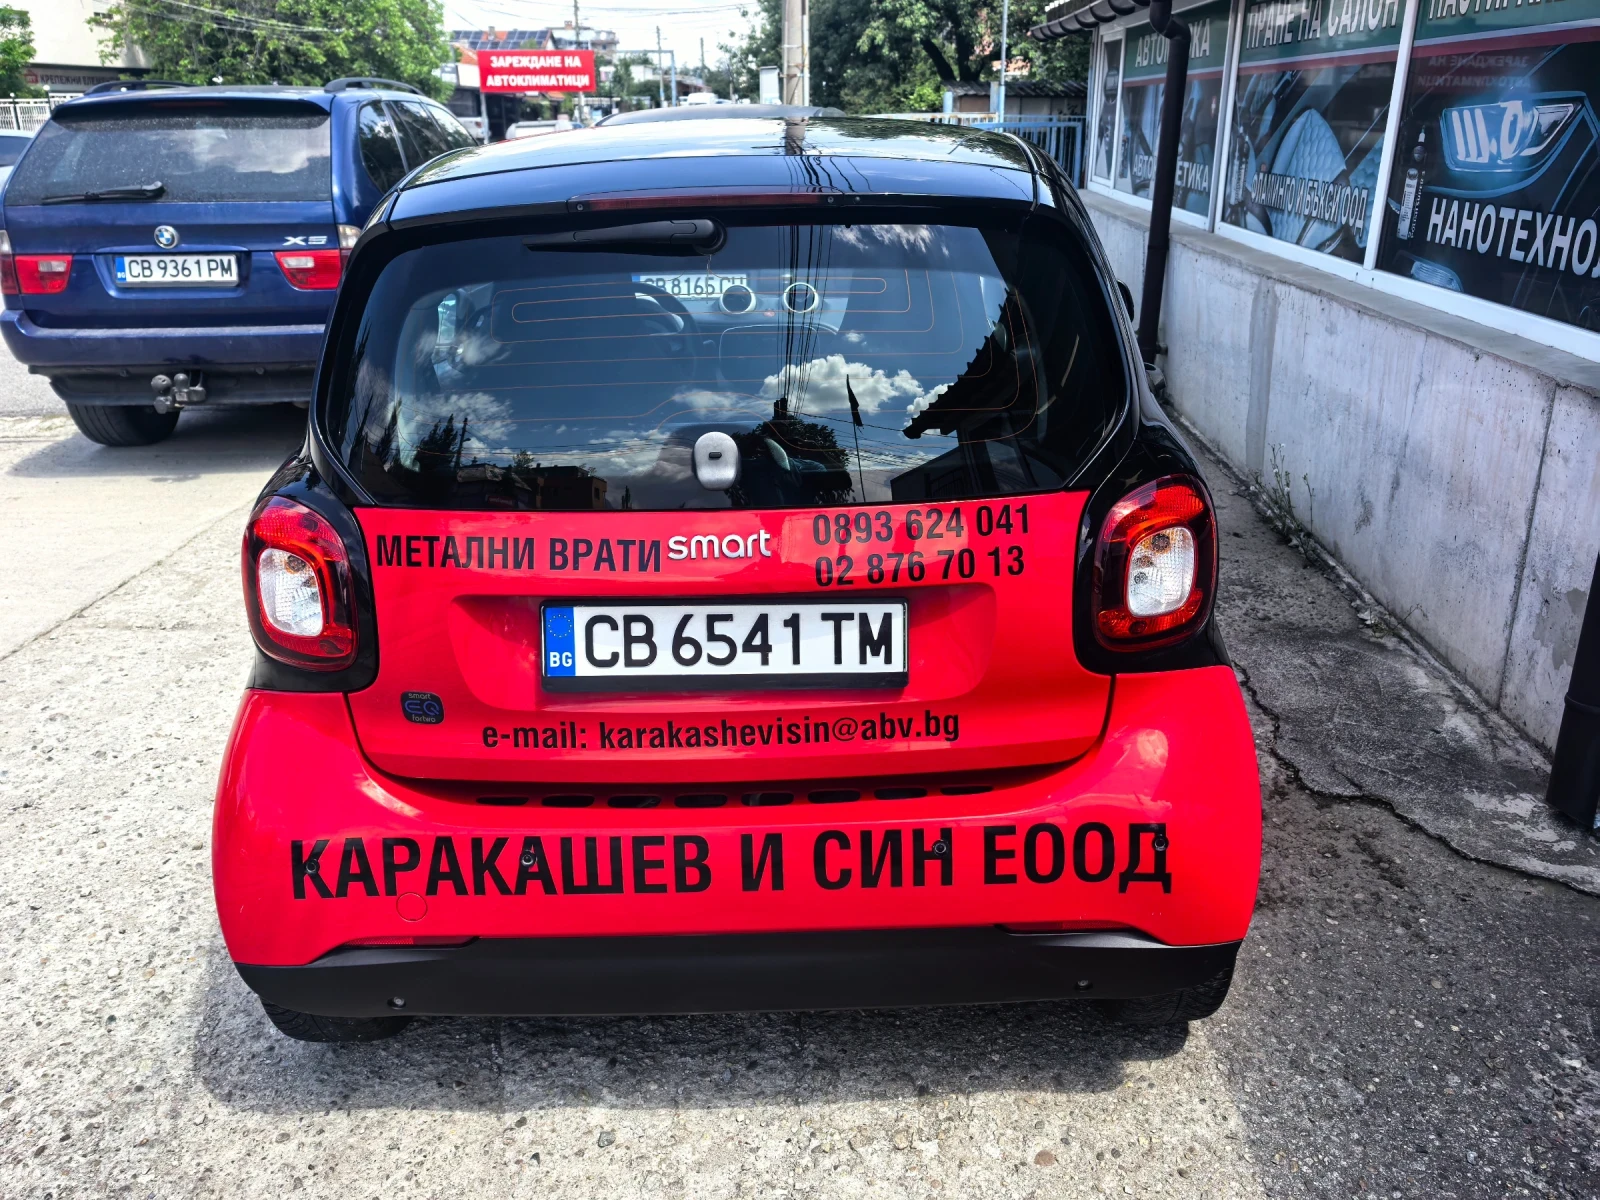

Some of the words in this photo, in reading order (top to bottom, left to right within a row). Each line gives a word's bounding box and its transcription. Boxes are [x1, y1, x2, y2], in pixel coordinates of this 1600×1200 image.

[1246, 1, 1295, 48] ПРАНЕ
[1298, 0, 1322, 41] НА
[1327, 0, 1398, 37] САЛОН
[490, 56, 562, 69] ЗАРЕЖДАНЕ
[564, 56, 582, 67] НА
[486, 75, 590, 88] АВТОКЛИМАТИЦИ
[1251, 171, 1296, 212] ФЛАМИНГО
[1341, 185, 1368, 238] ООД
[281, 235, 328, 246] X5
[128, 259, 153, 278] CB
[157, 259, 202, 278] 9361
[208, 258, 233, 278] PM
[671, 277, 715, 296] 8165
[813, 510, 893, 546] 0893
[906, 507, 964, 541] 624
[975, 503, 1029, 537] 041
[376, 535, 535, 570] МЕТАЛНИ
[549, 538, 661, 572] ВРАТИ
[667, 530, 771, 559] smart
[815, 555, 854, 587] 02
[867, 551, 926, 584] 876
[937, 547, 976, 580] 70
[987, 545, 1025, 577] 13
[584, 613, 658, 668] CB
[671, 612, 802, 668] 6541
[821, 612, 893, 665] TM
[549, 651, 573, 668] BG
[405, 700, 440, 715] EQ
[408, 692, 431, 700] smart
[412, 714, 436, 723] fortwo
[482, 721, 587, 749] e-mail:
[600, 709, 959, 749] karakashevisin@abv.bg
[290, 835, 712, 899] КАРАКАШЕВ
[740, 833, 784, 891] И
[813, 827, 953, 890] СИН
[983, 821, 1172, 894] ЕООД
